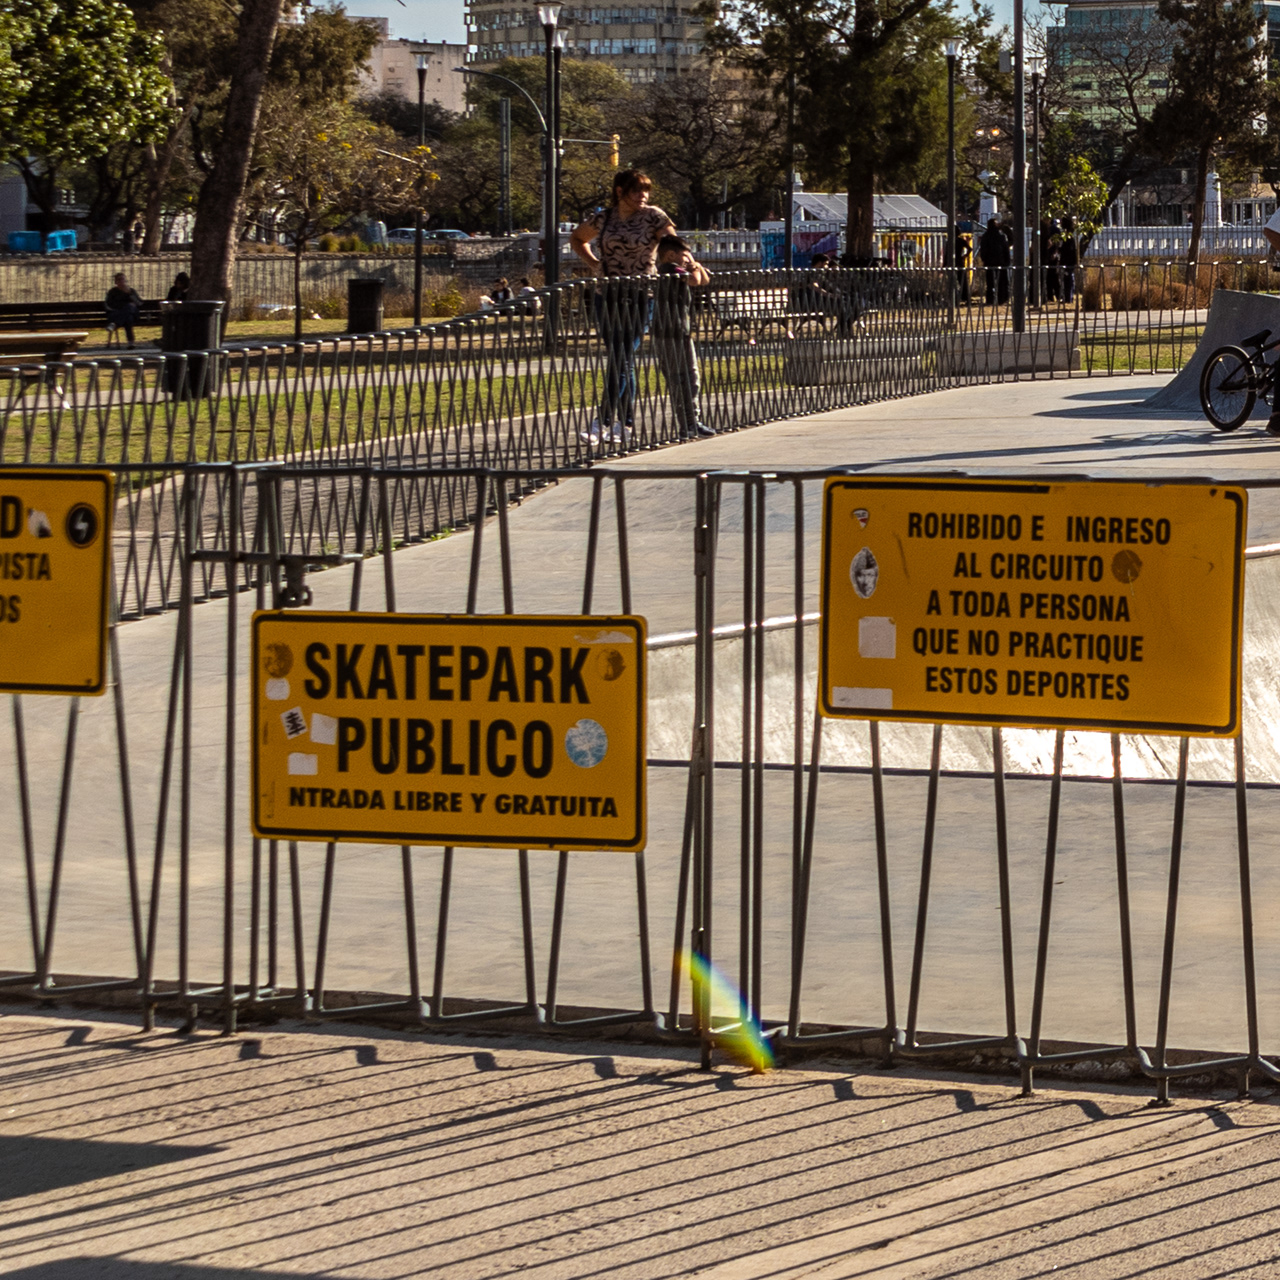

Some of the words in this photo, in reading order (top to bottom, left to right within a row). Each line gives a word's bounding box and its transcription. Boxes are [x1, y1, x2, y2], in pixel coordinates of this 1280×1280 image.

[0, 495, 24, 539] D
[907, 512, 1022, 541] ROHIBIDO
[1031, 515, 1045, 542] E
[1066, 515, 1171, 546] INGRESO
[0, 551, 52, 581] ISTA
[953, 551, 982, 579] AL
[990, 552, 1104, 583] CIRCUITO
[926, 589, 942, 616] A
[949, 590, 1011, 618] TODA
[1019, 592, 1131, 623] PERSONA
[912, 627, 959, 657] QUE
[968, 629, 1000, 657] NO
[1008, 630, 1144, 664] PRACTIQUE
[303, 641, 591, 705] SKATEPARK
[925, 666, 998, 696] ESTOS
[1006, 669, 1130, 702] DEPORTES
[337, 716, 554, 779] PUBLICO
[289, 786, 386, 810] NTRADA
[393, 790, 463, 813] LIBRE
[470, 792, 487, 814] Y
[494, 793, 618, 818] GRATUITA
